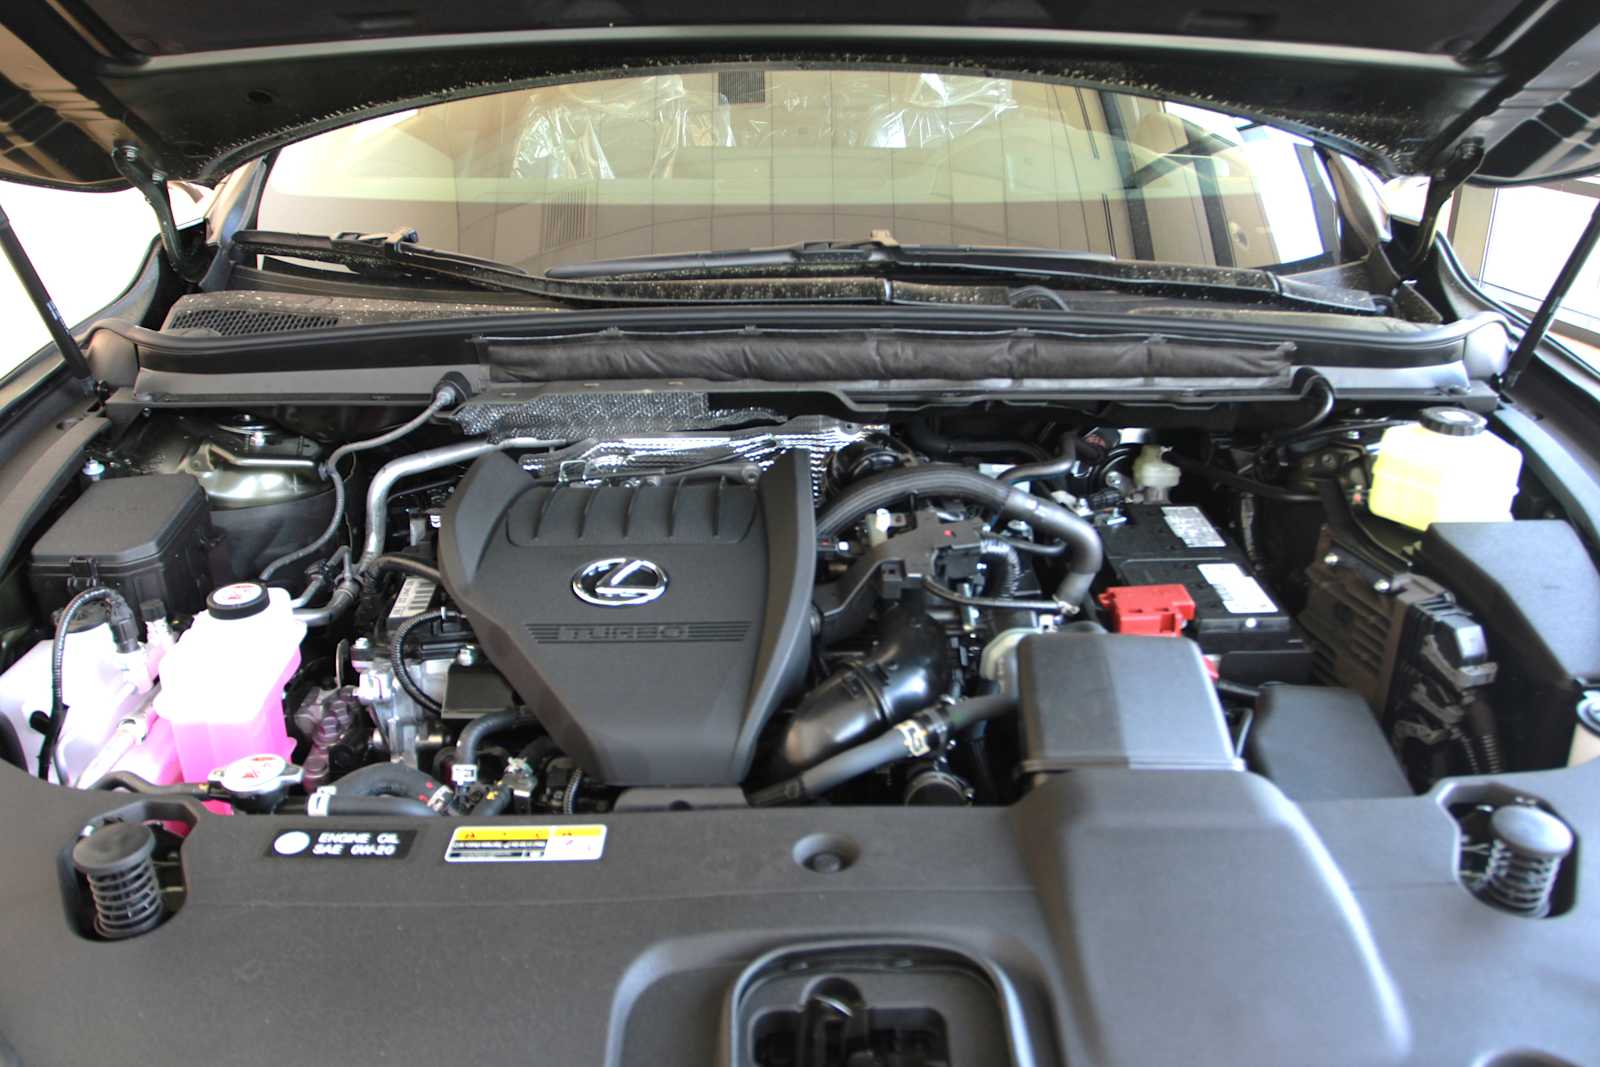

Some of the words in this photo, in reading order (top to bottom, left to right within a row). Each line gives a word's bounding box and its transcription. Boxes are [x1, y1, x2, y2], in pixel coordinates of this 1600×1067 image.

[318, 832, 370, 843] ENGINE
[377, 833, 399, 844] OIL
[312, 843, 343, 855] SAE
